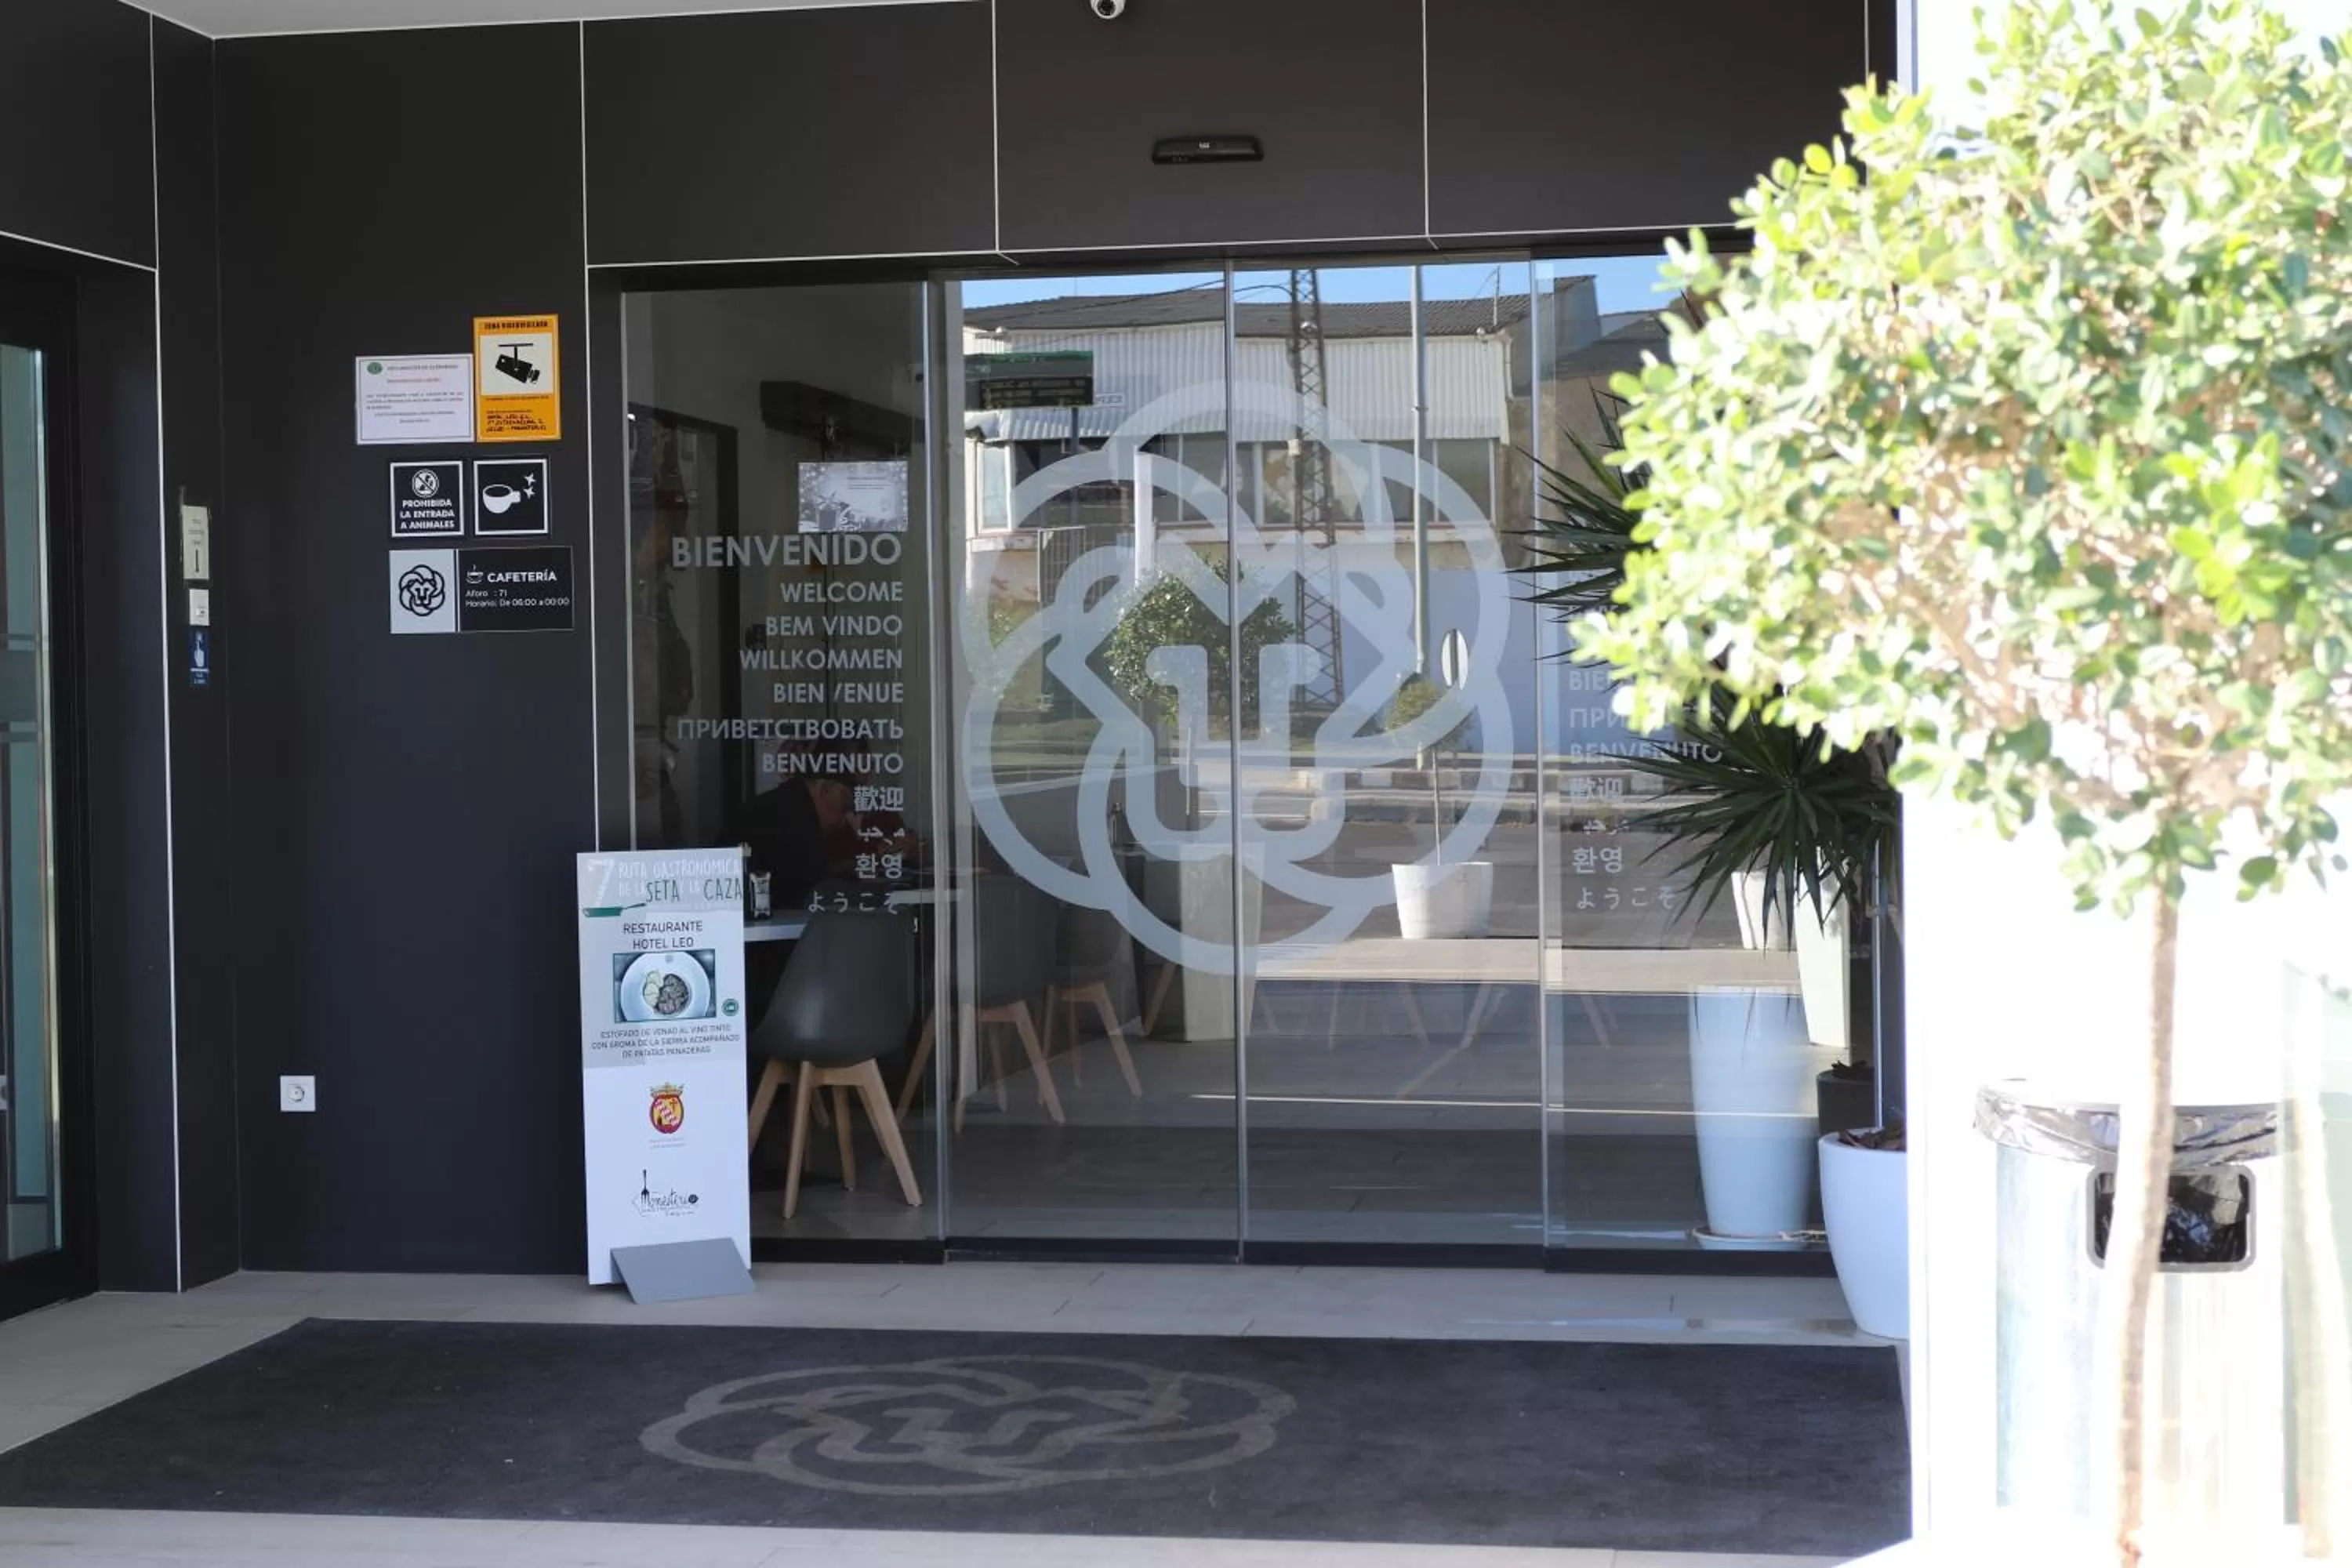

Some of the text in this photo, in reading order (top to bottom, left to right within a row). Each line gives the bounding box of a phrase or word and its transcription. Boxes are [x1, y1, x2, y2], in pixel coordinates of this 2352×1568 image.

[402, 499, 452, 507] PROHIBIDA
[413, 509, 455, 518] ENTRADA
[408, 520, 455, 529] ANIMALES
[672, 533, 902, 568] BIENVENIDO
[487, 568, 557, 583] CAFETERÍA
[465, 589, 488, 598] Aforo
[780, 581, 904, 603] WELCOME
[766, 615, 903, 637] BEM VINDO
[739, 648, 903, 670] WILLKOMMEN
[677, 718, 904, 741] ПРИВЕТСТВОВАТЬ
[762, 753, 904, 774] BENVENUTO
[853, 786, 904, 812] 歡迎
[854, 852, 904, 880] 환영
[1572, 846, 1624, 874] 환영
[645, 878, 680, 902] SETA
[703, 877, 742, 902] CAZA
[1577, 886, 1677, 911] ようこそ
[623, 920, 703, 935] RESTAURANTE
[633, 937, 694, 950] HOTEL LEO
